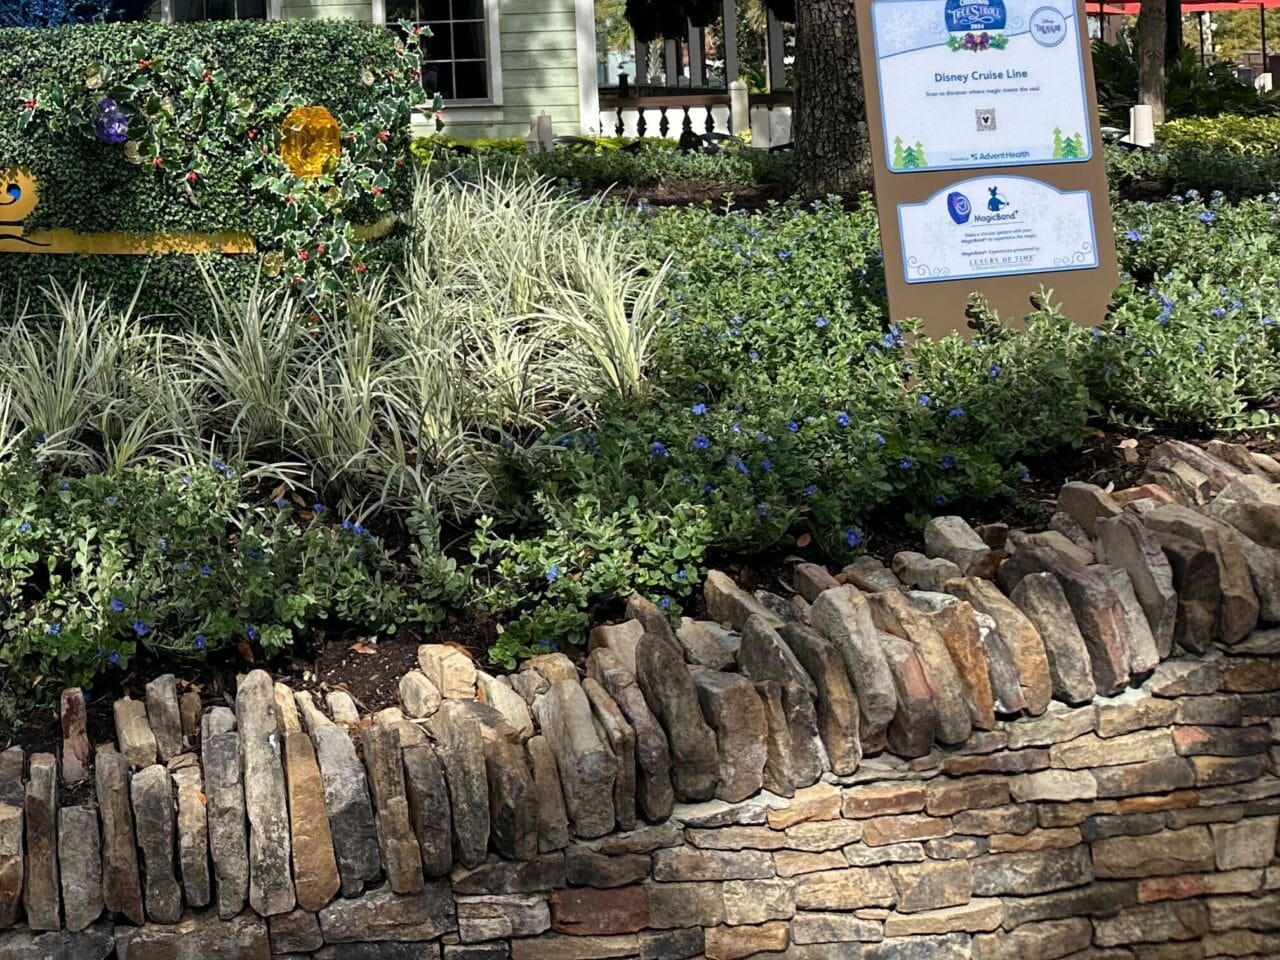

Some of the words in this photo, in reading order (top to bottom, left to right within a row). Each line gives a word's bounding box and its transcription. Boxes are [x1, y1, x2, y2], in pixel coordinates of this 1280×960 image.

[934, 72, 969, 84] Disney
[971, 70, 1004, 81] Cruise
[1006, 69, 1028, 79] Line
[979, 151, 1030, 161] AdventHealth
